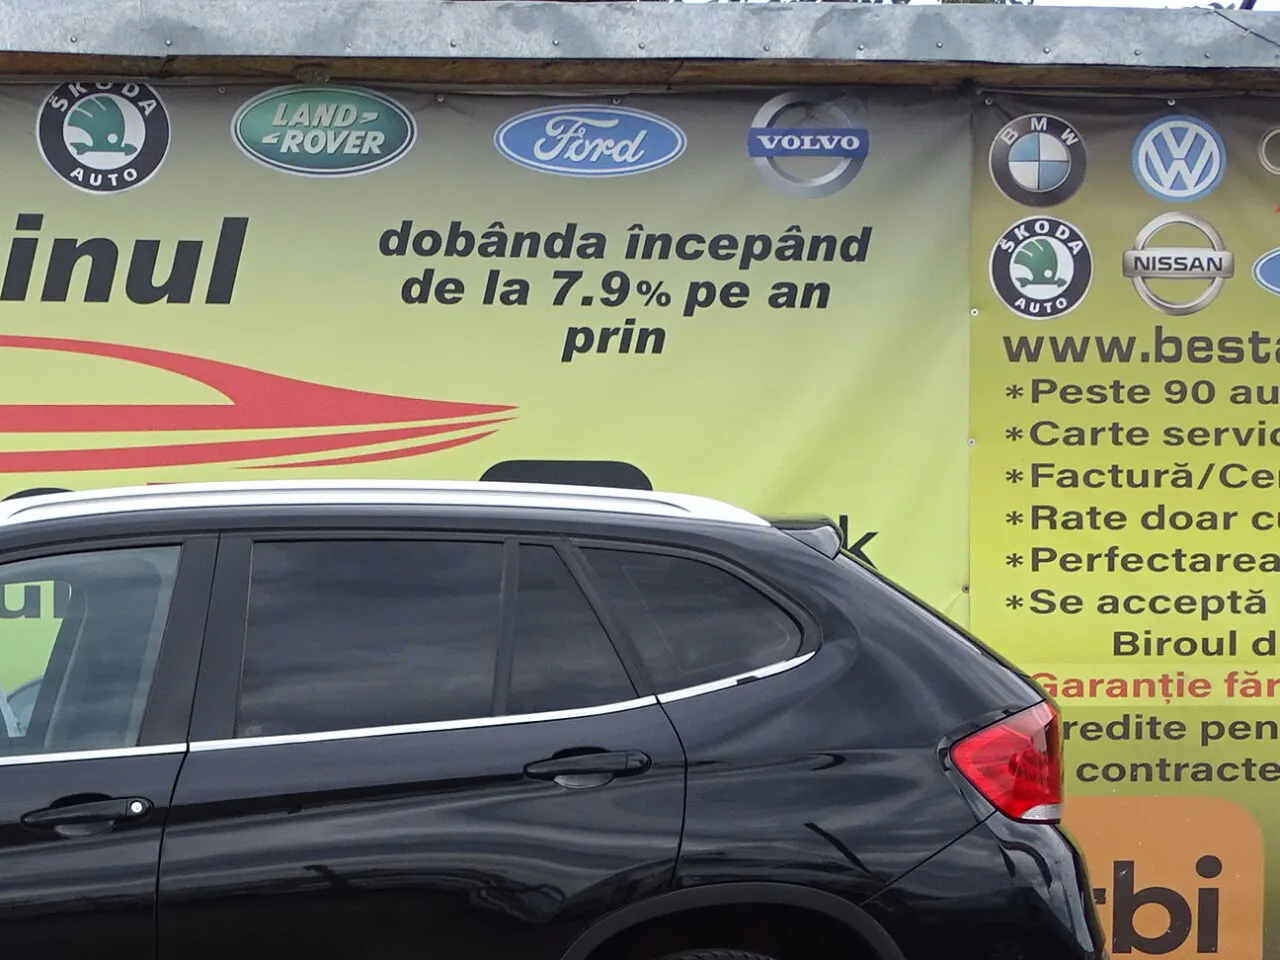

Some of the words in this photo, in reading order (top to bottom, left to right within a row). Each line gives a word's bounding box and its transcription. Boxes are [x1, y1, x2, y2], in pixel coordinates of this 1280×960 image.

[533, 112, 645, 167] Ford
[756, 134, 861, 151] VOLVO
[1000, 116, 1079, 147] BMW
[70, 167, 138, 187] AUTO
[378, 220, 607, 260] dobânda
[624, 223, 873, 270] începând
[1133, 255, 1224, 272] NISSAN
[401, 268, 465, 305] de
[482, 269, 531, 306] la
[683, 279, 750, 317] pe
[768, 278, 831, 309] an
[1014, 297, 1068, 314] AUTO
[561, 318, 666, 363] prin
[1003, 325, 1280, 364] www.best
[1163, 379, 1216, 405] 90
[1140, 503, 1239, 531] doar
[1096, 588, 1267, 621] acceptă
[1113, 629, 1238, 656] Biroul
[1200, 720, 1279, 747] pen
[1075, 757, 1280, 783] contracte
[1092, 854, 1223, 956] bi
